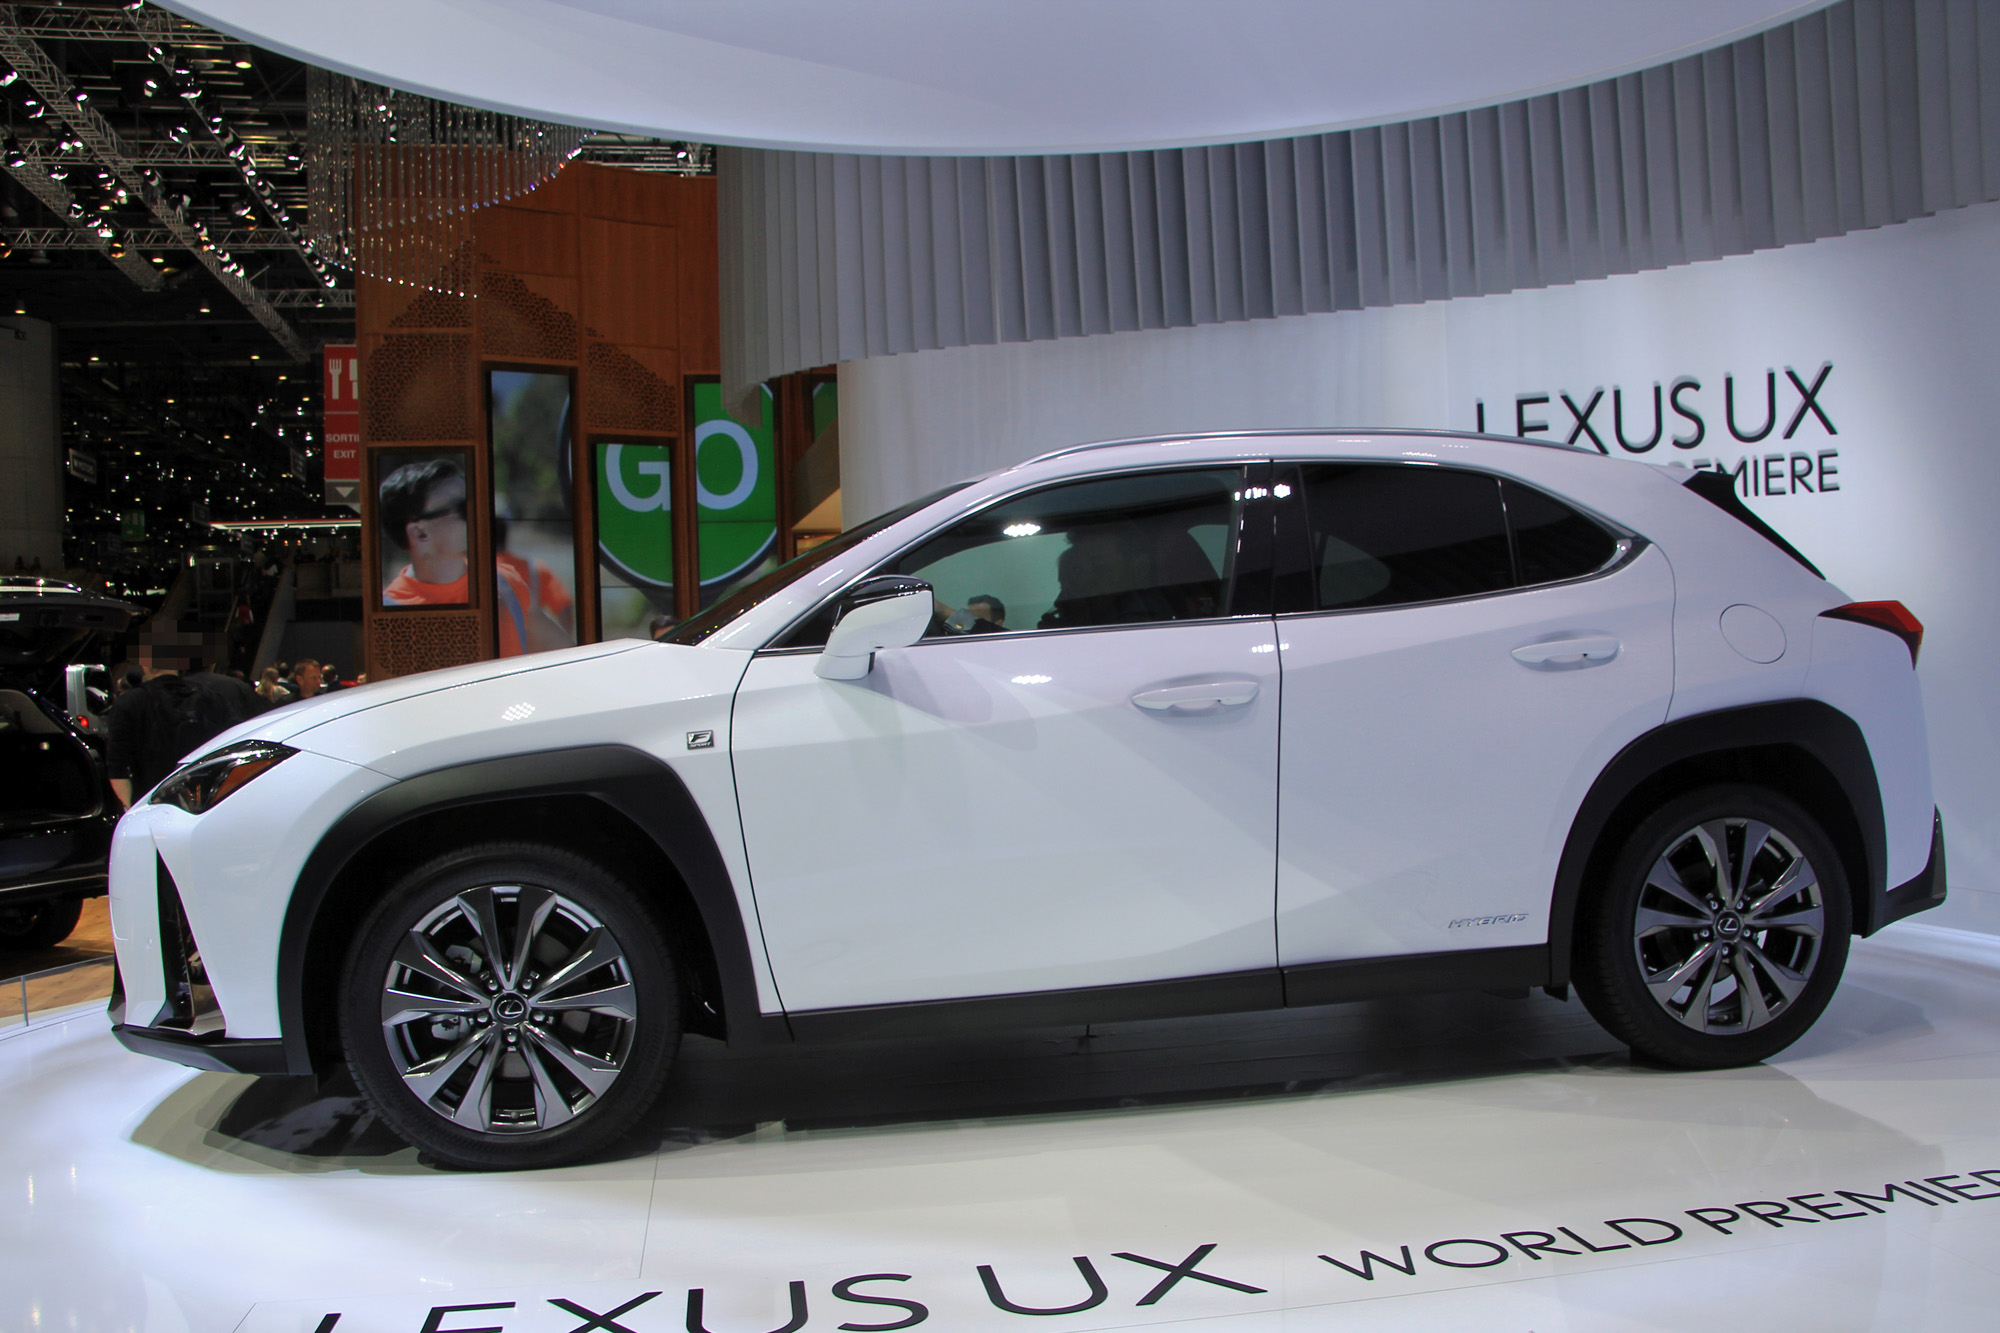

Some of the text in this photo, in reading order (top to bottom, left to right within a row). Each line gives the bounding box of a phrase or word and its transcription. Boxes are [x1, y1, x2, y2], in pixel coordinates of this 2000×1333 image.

[1725, 364, 1838, 443] UX
[333, 450, 357, 459] EXIT
[605, 418, 759, 512] GO
[1448, 913, 1529, 929] HYBRID
[976, 1243, 1268, 1316] UX
[1317, 1217, 1683, 1281] WORLD
